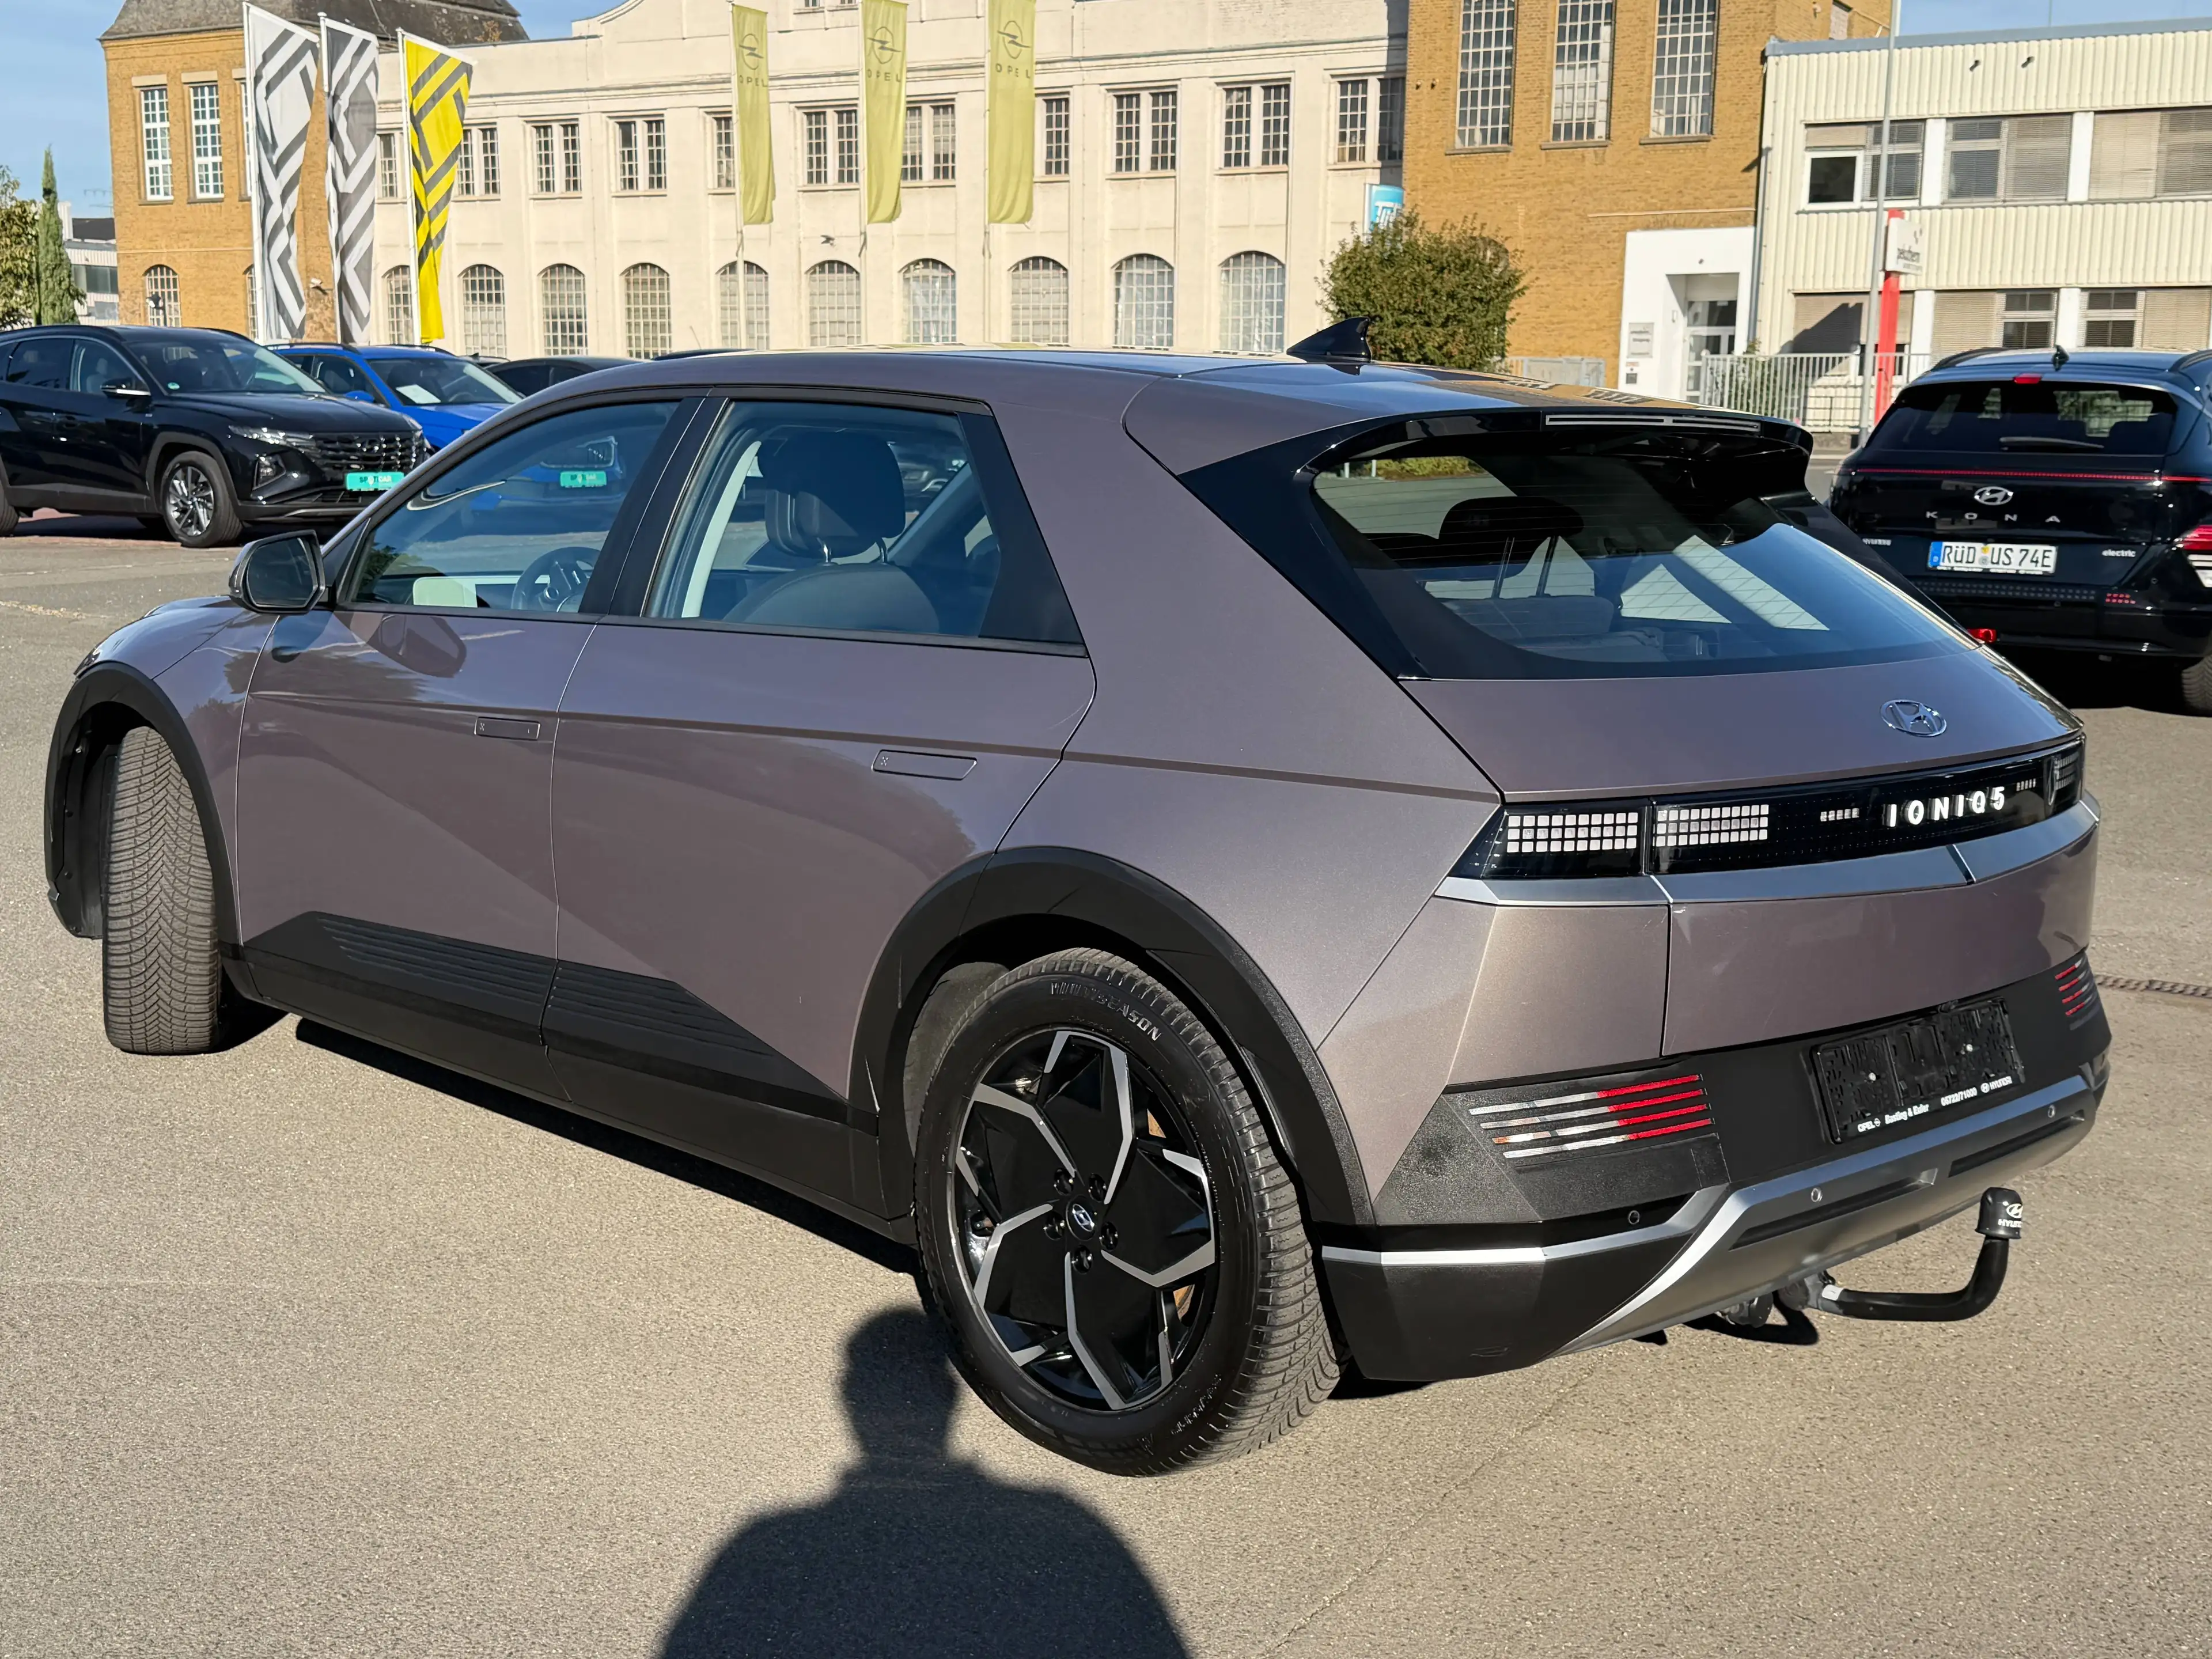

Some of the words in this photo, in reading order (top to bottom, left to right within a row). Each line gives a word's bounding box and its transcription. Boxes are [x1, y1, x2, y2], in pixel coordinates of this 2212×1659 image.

[867, 69, 902, 82] OPEL
[995, 63, 1031, 79] OPEL
[739, 75, 768, 87] OPEL
[1926, 511, 2061, 522] KONA
[1941, 546, 1976, 564] RÜD
[1990, 547, 2014, 566] US
[2018, 548, 2052, 568] 74E
[2101, 549, 2136, 557] electric
